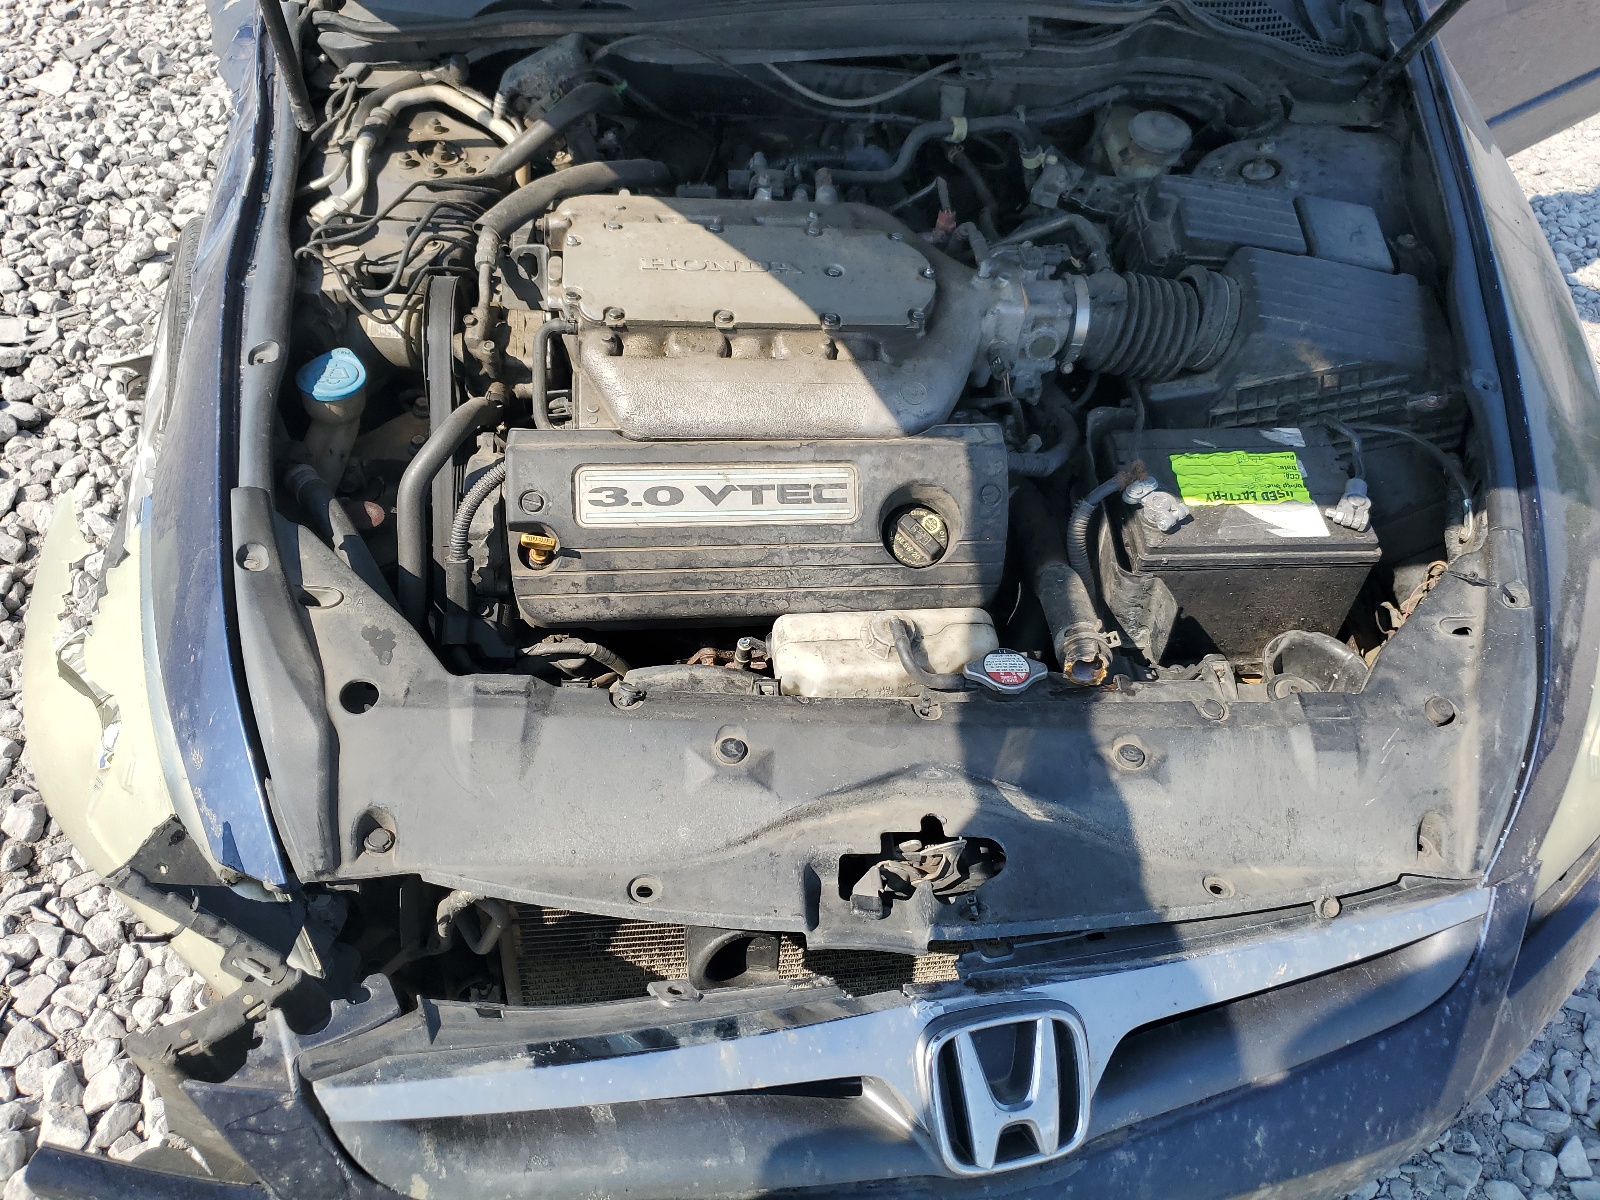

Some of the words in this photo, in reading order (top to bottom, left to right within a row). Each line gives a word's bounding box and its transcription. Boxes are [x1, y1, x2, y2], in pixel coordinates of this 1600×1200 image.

[638, 257, 804, 274] HONDA
[587, 486, 684, 507] 3.0
[695, 483, 848, 506] VTEC
